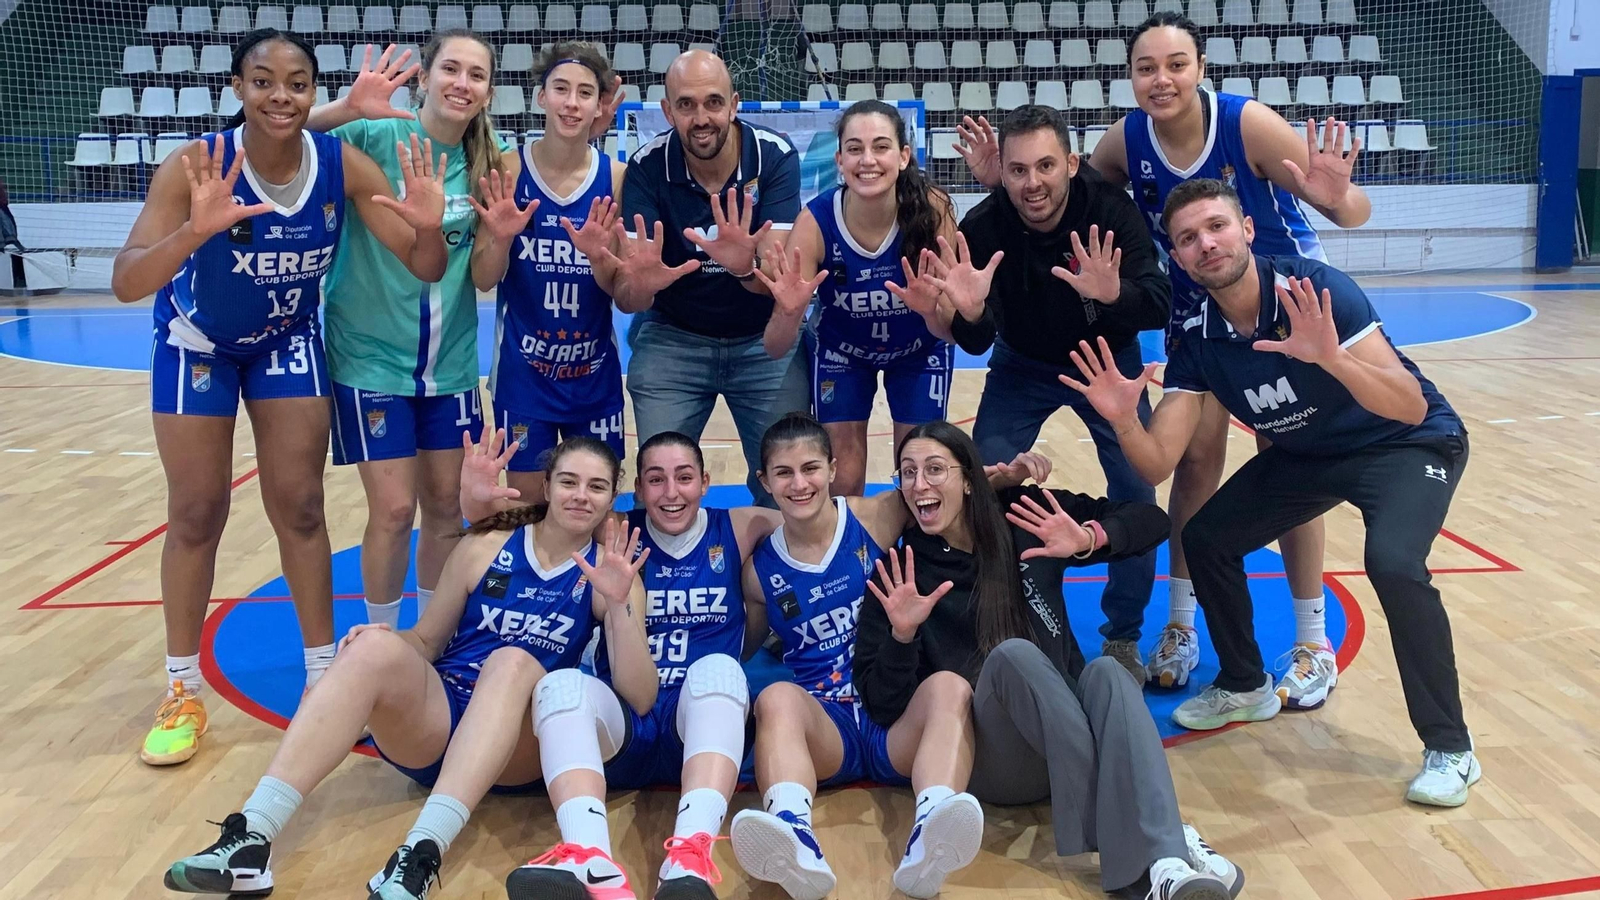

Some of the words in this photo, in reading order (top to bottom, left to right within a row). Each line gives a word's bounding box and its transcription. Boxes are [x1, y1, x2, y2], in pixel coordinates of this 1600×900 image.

[231, 243, 335, 277] XEREZ
[518, 236, 592, 266] XERE
[254, 277, 280, 286] CLUB
[536, 264, 556, 272] CLUB
[558, 266, 594, 275] DEPORT
[267, 288, 302, 318] 13
[544, 282, 580, 318] 44
[832, 289, 906, 312] XERE
[872, 322, 890, 342] 4
[266, 337, 309, 376] 13
[928, 374, 944, 408] 4
[454, 387, 482, 426] 14
[1254, 406, 1318, 430] MundoMÓVIL
[590, 411, 624, 442] 44
[1272, 420, 1308, 434] Network
[823, 574, 850, 590] Diputación
[646, 587, 728, 616] EREZ
[476, 604, 575, 645] XEREZ
[671, 614, 727, 624] DEPORTIVO
[792, 596, 865, 650] XERE
[518, 634, 565, 654] PORTIVO
[647, 628, 689, 662] 99
[818, 637, 840, 652] CLUB
